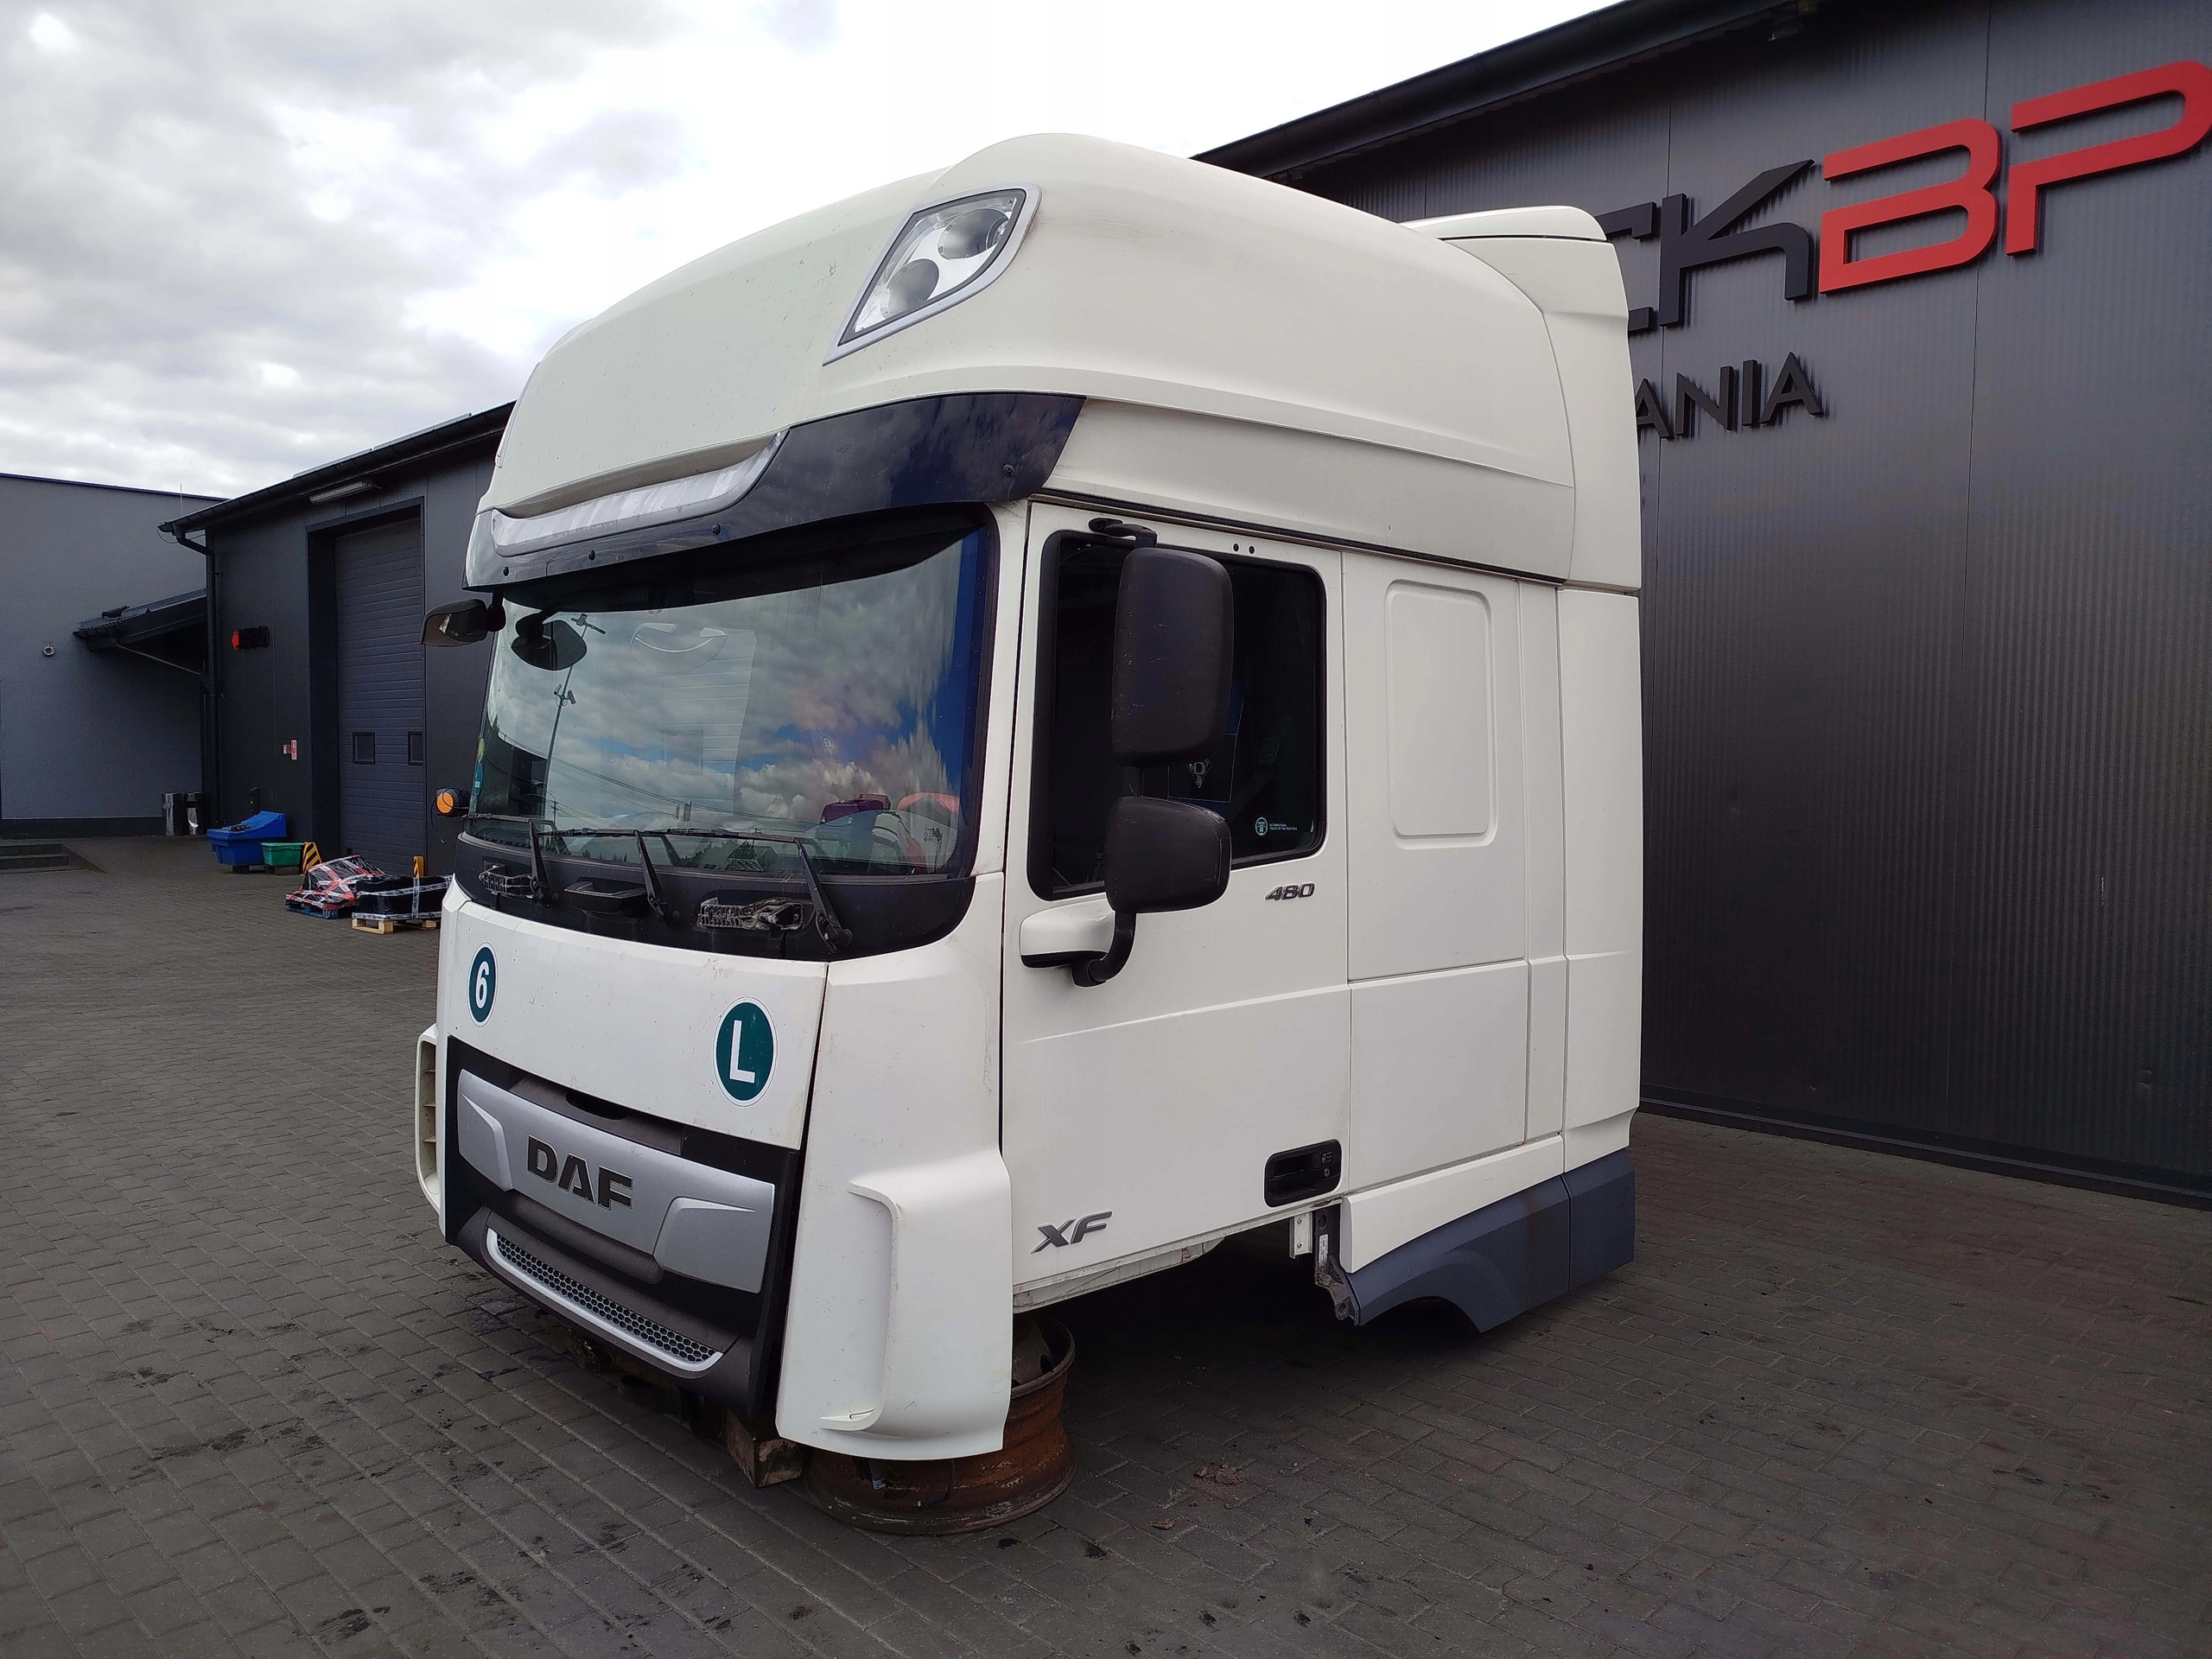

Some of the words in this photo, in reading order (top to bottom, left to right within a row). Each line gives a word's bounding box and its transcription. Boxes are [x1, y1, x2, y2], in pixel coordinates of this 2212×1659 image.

[1265, 882, 1315, 900] 480
[475, 961, 490, 1009] 6
[729, 1020, 756, 1084] L
[526, 1134, 633, 1211] DAF
[1030, 1210, 1113, 1255] XF
